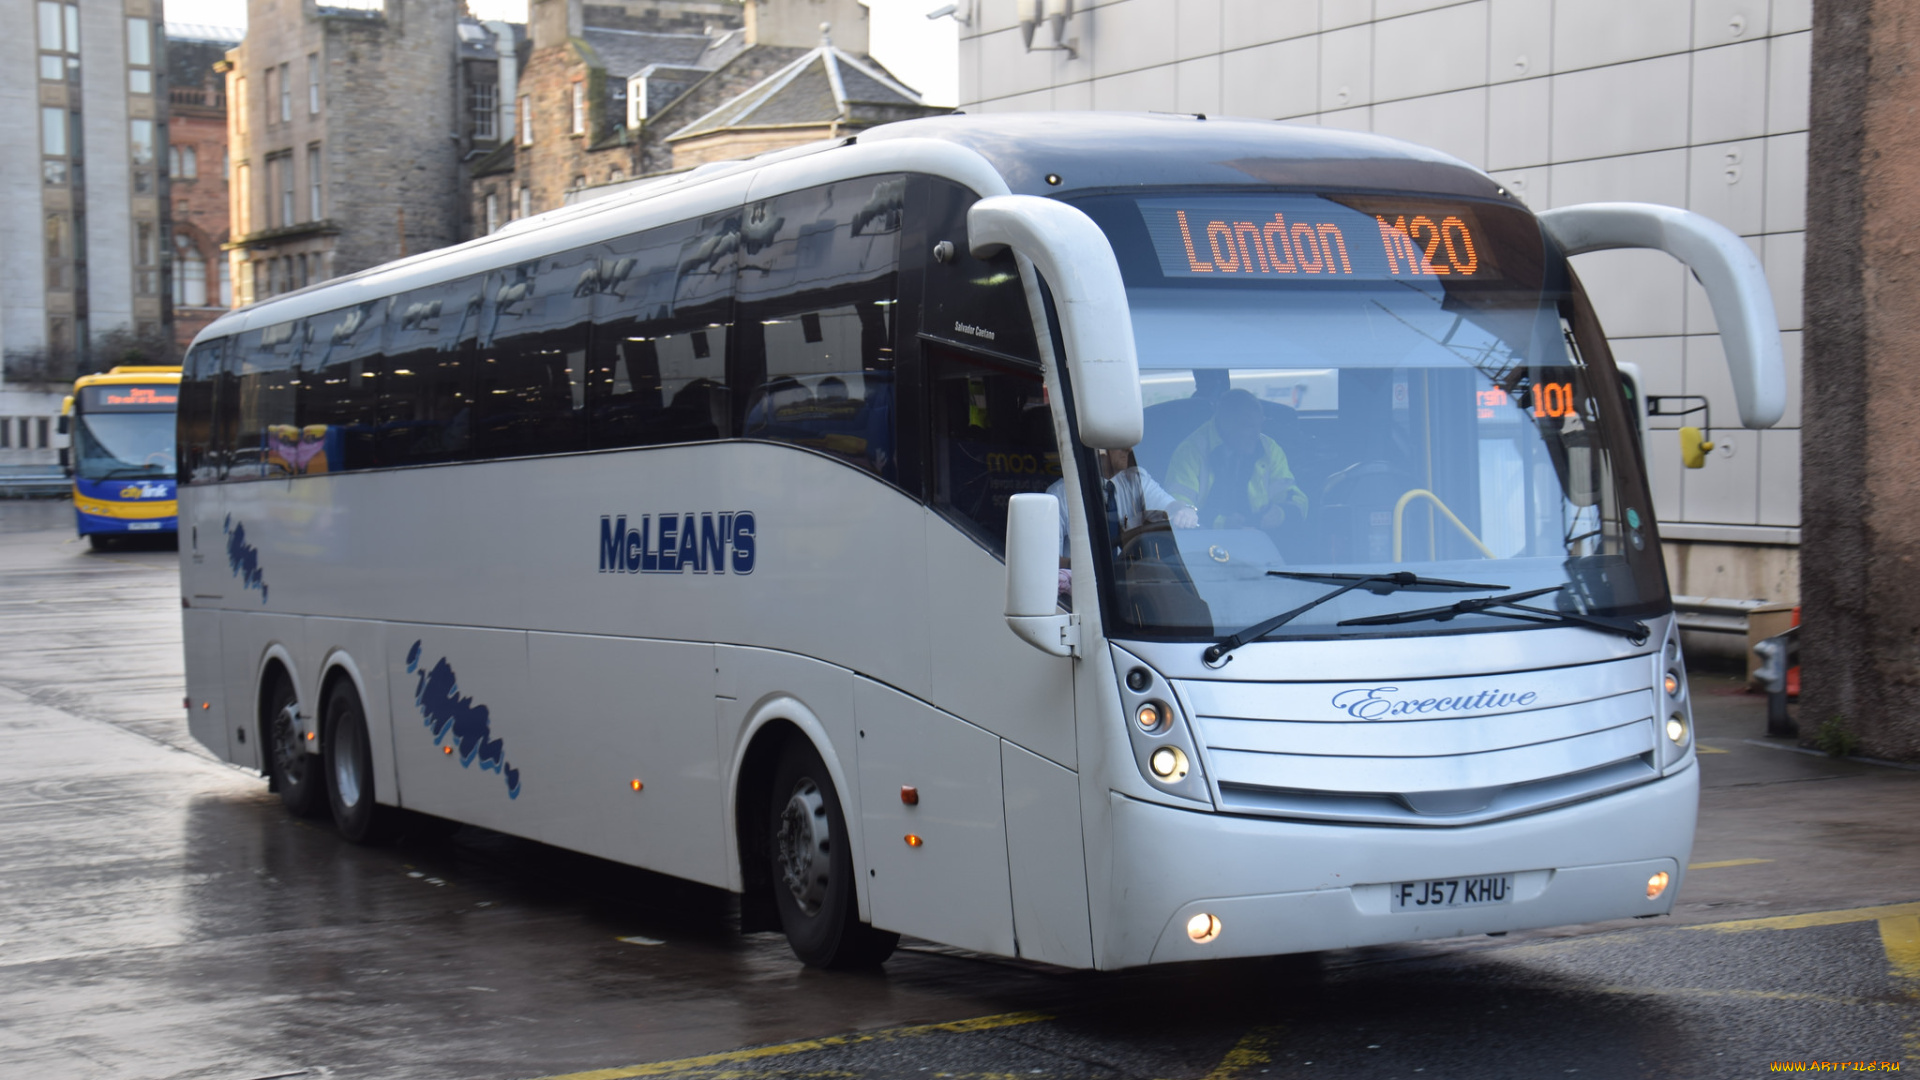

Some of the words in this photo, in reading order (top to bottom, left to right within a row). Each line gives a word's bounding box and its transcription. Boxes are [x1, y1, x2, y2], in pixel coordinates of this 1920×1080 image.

[1176, 209, 1353, 275] London
[1375, 214, 1479, 276] M20
[954, 320, 975, 335] Salvador
[975, 325, 995, 340] Caetano
[1532, 382, 1577, 418] 101
[599, 510, 756, 575] McLEAN'S
[1331, 686, 1538, 721] Executive
[1400, 881, 1459, 907] FJ57
[1464, 878, 1506, 903] KHU
